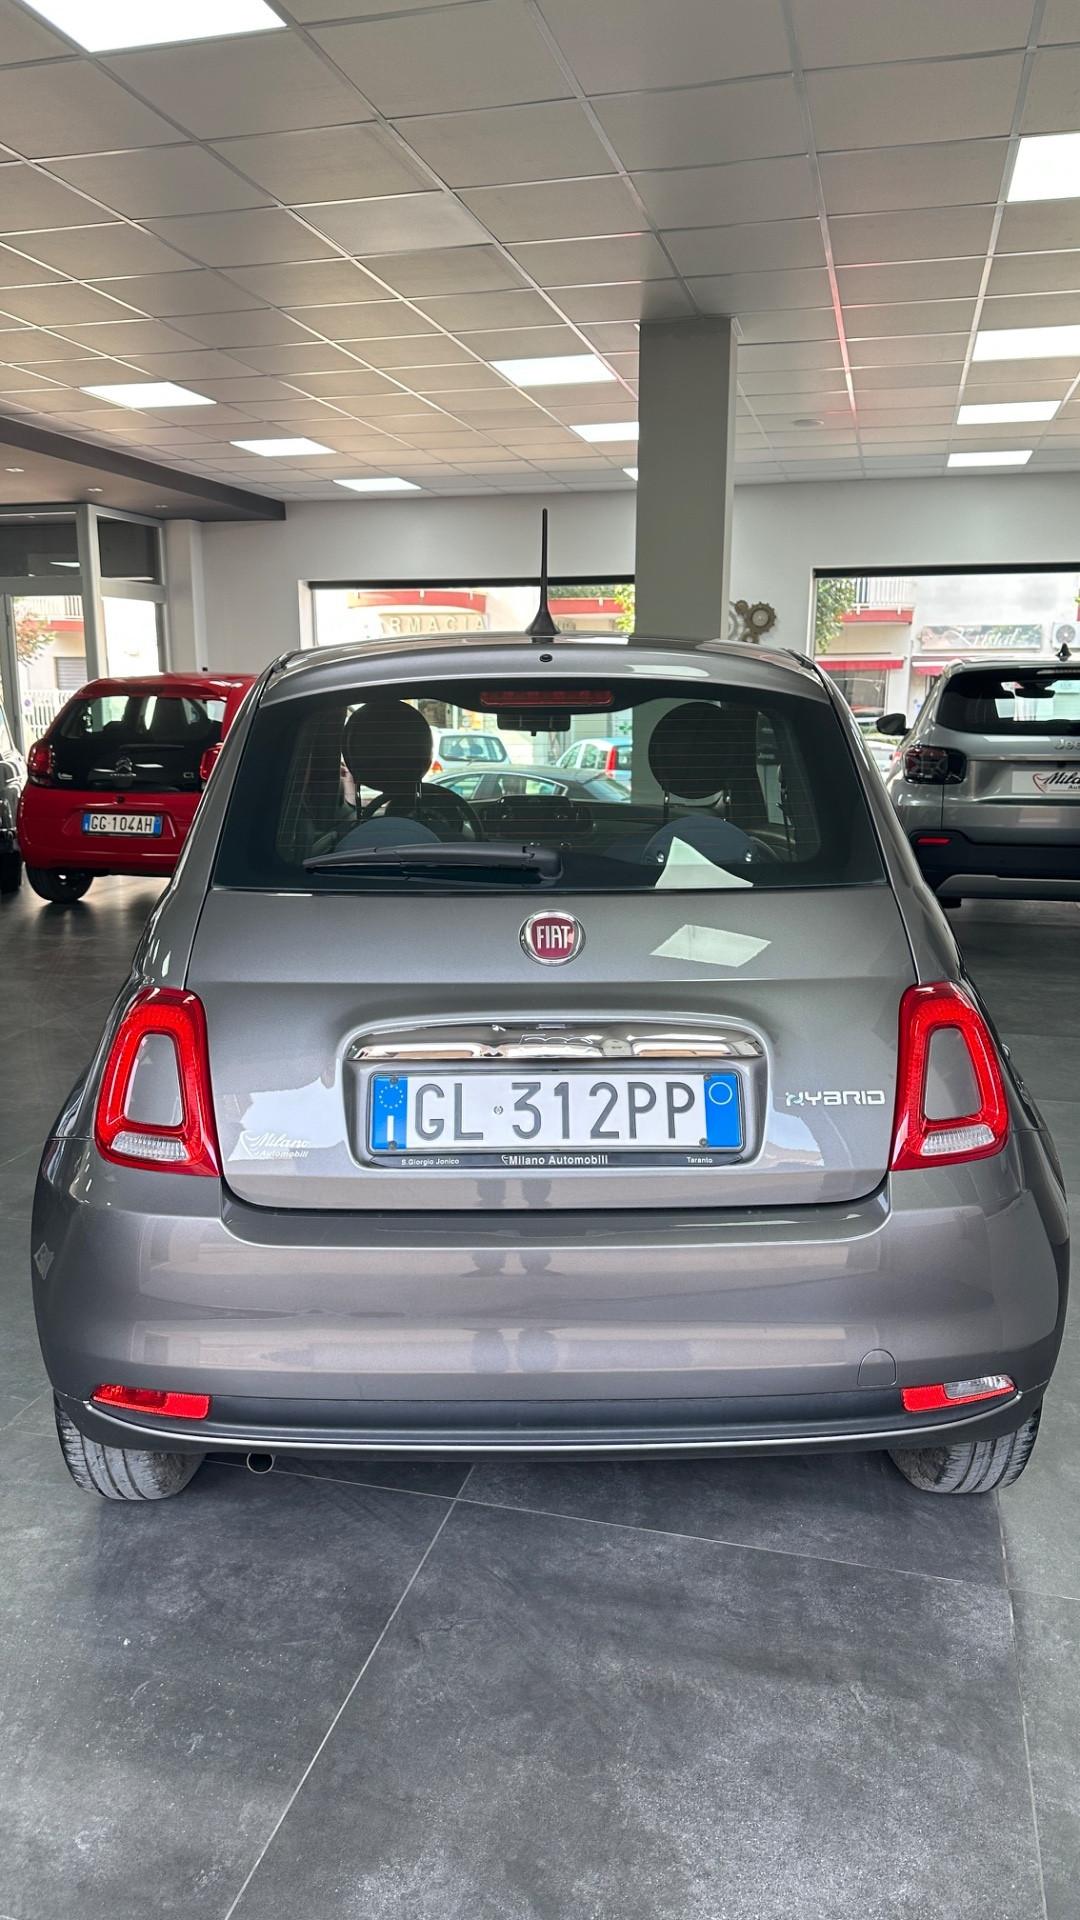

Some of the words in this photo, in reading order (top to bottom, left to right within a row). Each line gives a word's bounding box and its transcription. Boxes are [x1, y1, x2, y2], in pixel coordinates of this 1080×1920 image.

[365, 615, 490, 635] ARMACIA
[1054, 738, 1080, 751] Jee
[91, 815, 107, 830] GG
[112, 816, 153, 832] 104AH
[536, 925, 571, 949] FIAT
[785, 1090, 886, 1106] HYBRID
[415, 1083, 484, 1141] GL
[511, 1081, 696, 1140] 312PP
[509, 1155, 545, 1165] Milano
[548, 1154, 609, 1165] Automobili
[686, 1156, 713, 1164] Taranto
